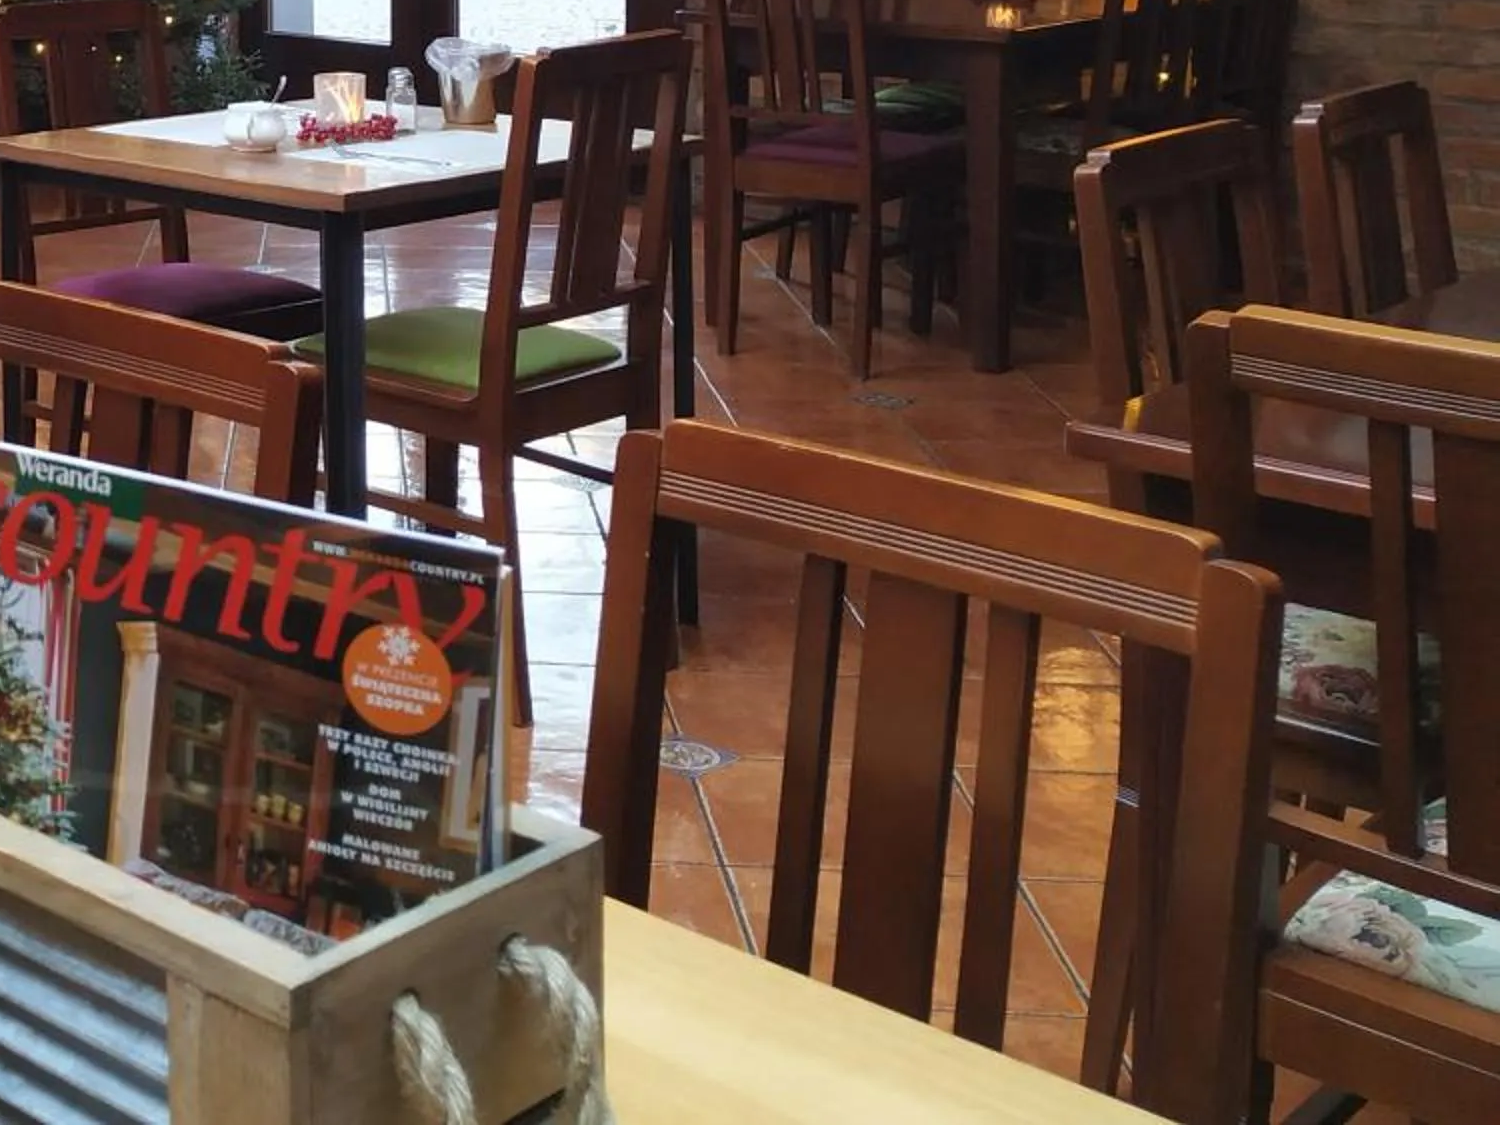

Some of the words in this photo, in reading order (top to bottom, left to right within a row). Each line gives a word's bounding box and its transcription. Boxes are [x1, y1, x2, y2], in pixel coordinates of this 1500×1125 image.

[16, 452, 112, 497] Weranda
[318, 724, 350, 739] TRZY
[354, 733, 388, 749] RAZY
[327, 739, 340, 751] W
[341, 791, 353, 803] W
[368, 783, 401, 800] DOM
[342, 834, 420, 860] MALOWANE
[361, 852, 381, 866] NA
